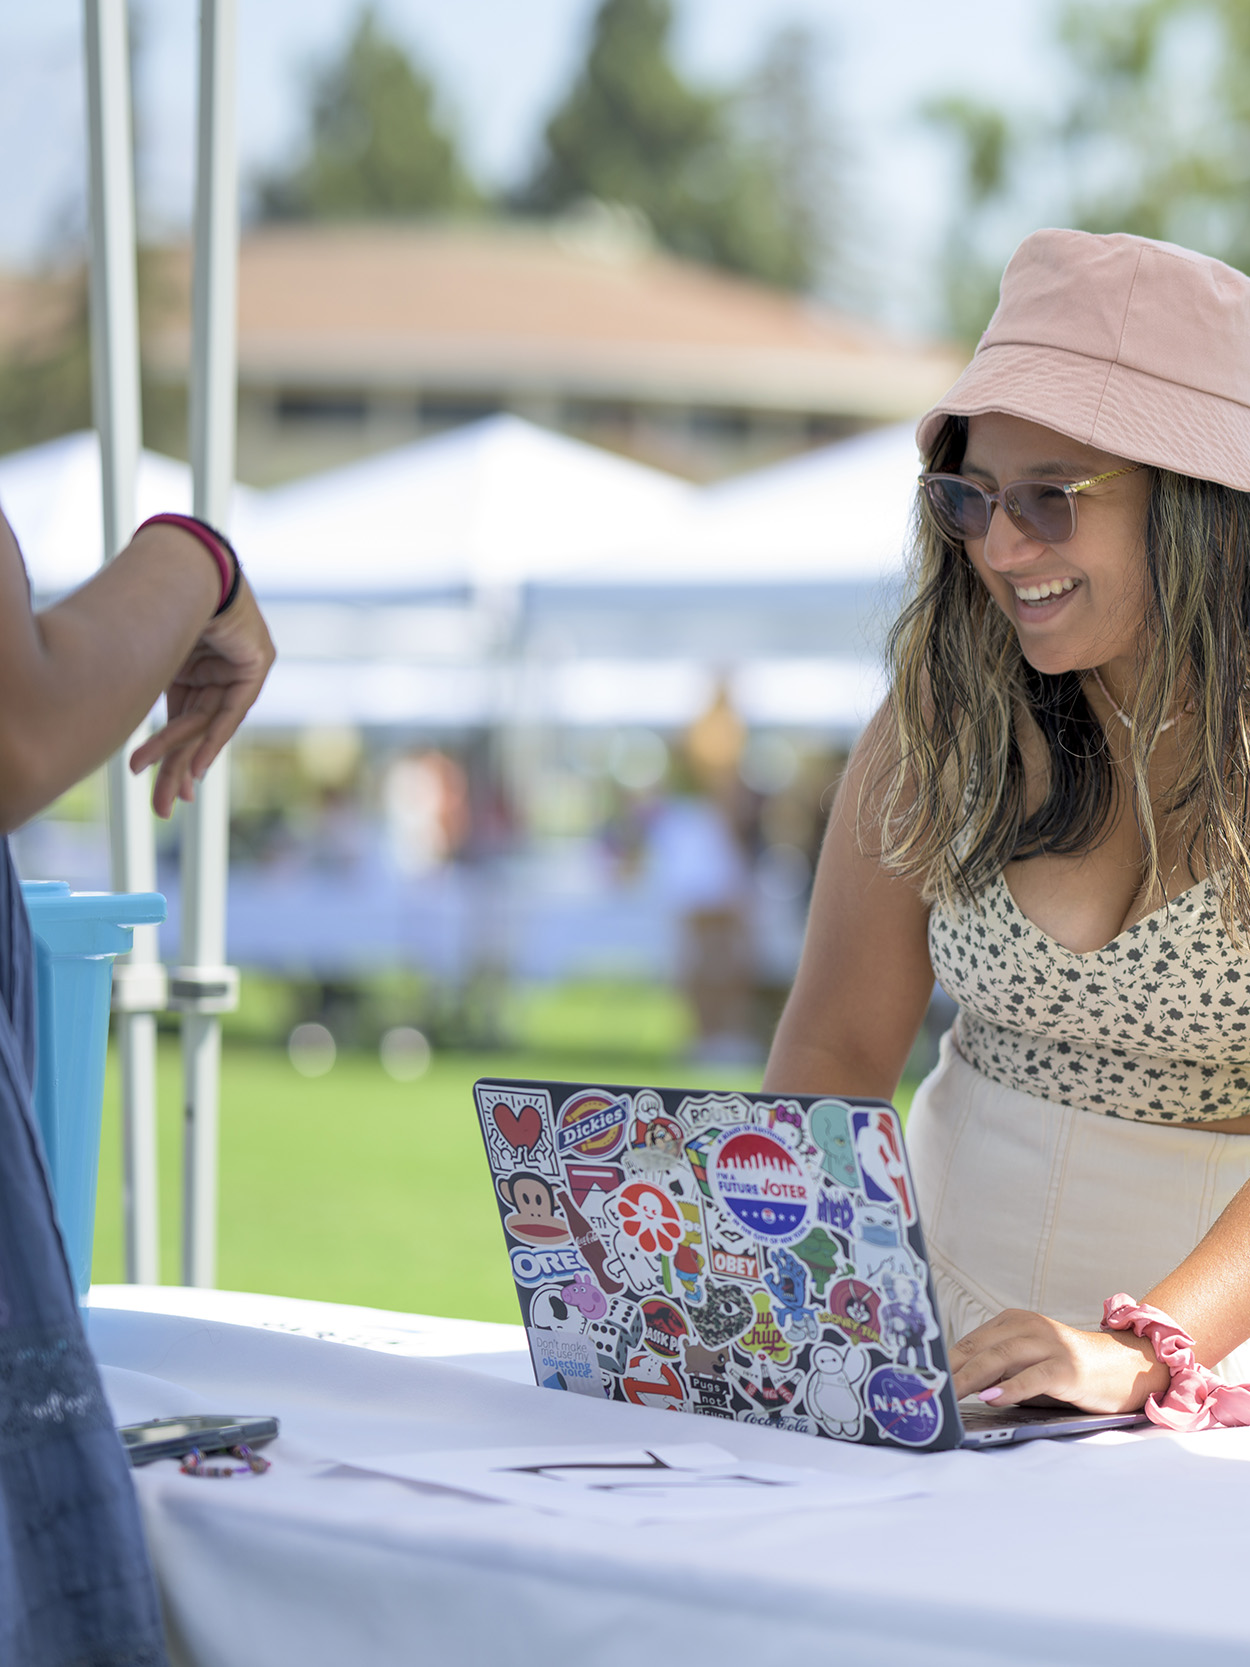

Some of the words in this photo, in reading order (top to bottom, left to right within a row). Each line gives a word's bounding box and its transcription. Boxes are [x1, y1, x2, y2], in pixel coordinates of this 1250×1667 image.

[690, 1105, 739, 1124] ROUTE
[563, 1108, 624, 1146] Dickies
[718, 1181, 759, 1195] FUTURE
[714, 1253, 756, 1276] OBEY
[818, 1312, 860, 1332] LOONEY
[536, 1337, 559, 1350] Don't
[561, 1341, 587, 1353] make
[541, 1347, 555, 1357] me
[557, 1350, 573, 1360] use
[575, 1352, 589, 1364] my
[542, 1356, 592, 1374] objecting
[561, 1367, 593, 1379] voice.
[872, 1394, 936, 1419] NASA
